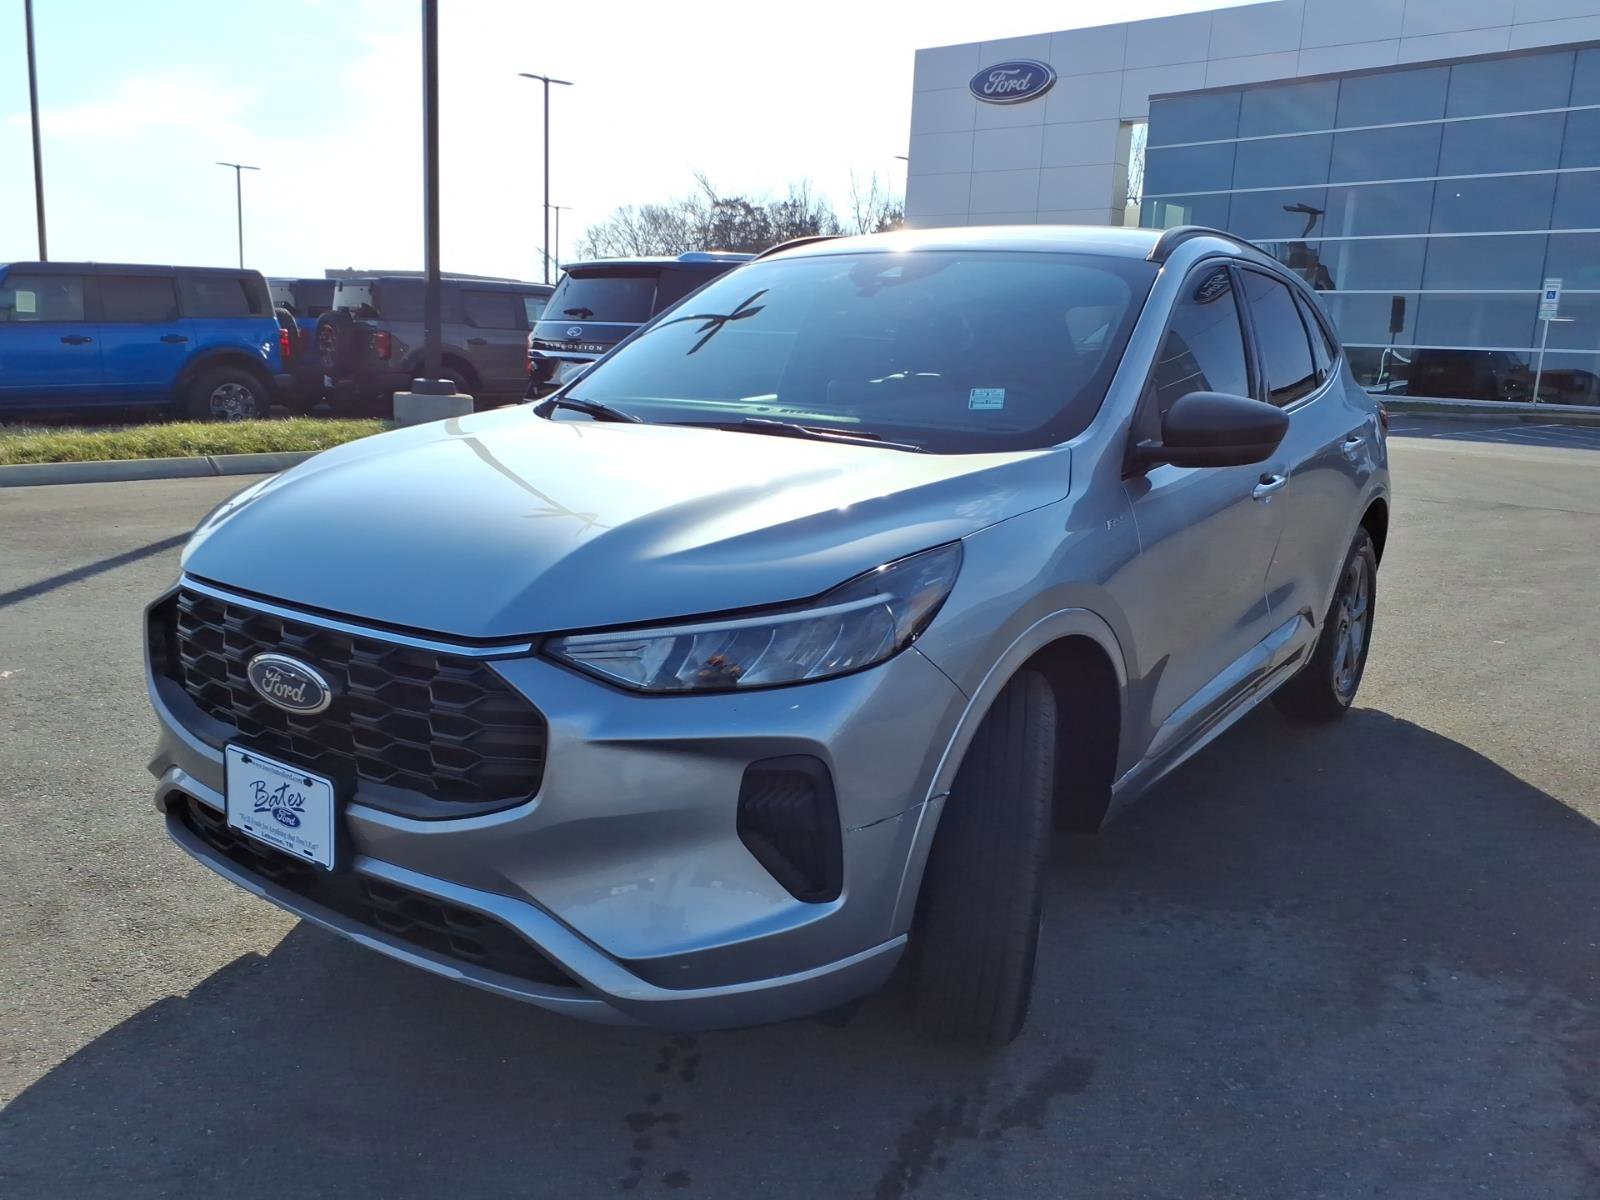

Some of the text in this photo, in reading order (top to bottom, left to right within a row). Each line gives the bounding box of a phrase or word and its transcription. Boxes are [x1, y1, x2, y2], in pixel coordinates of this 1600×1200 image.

[983, 69, 1033, 94] Ford
[262, 665, 306, 703] Ford
[249, 780, 306, 808] Bates
[276, 809, 297, 826] Ford
